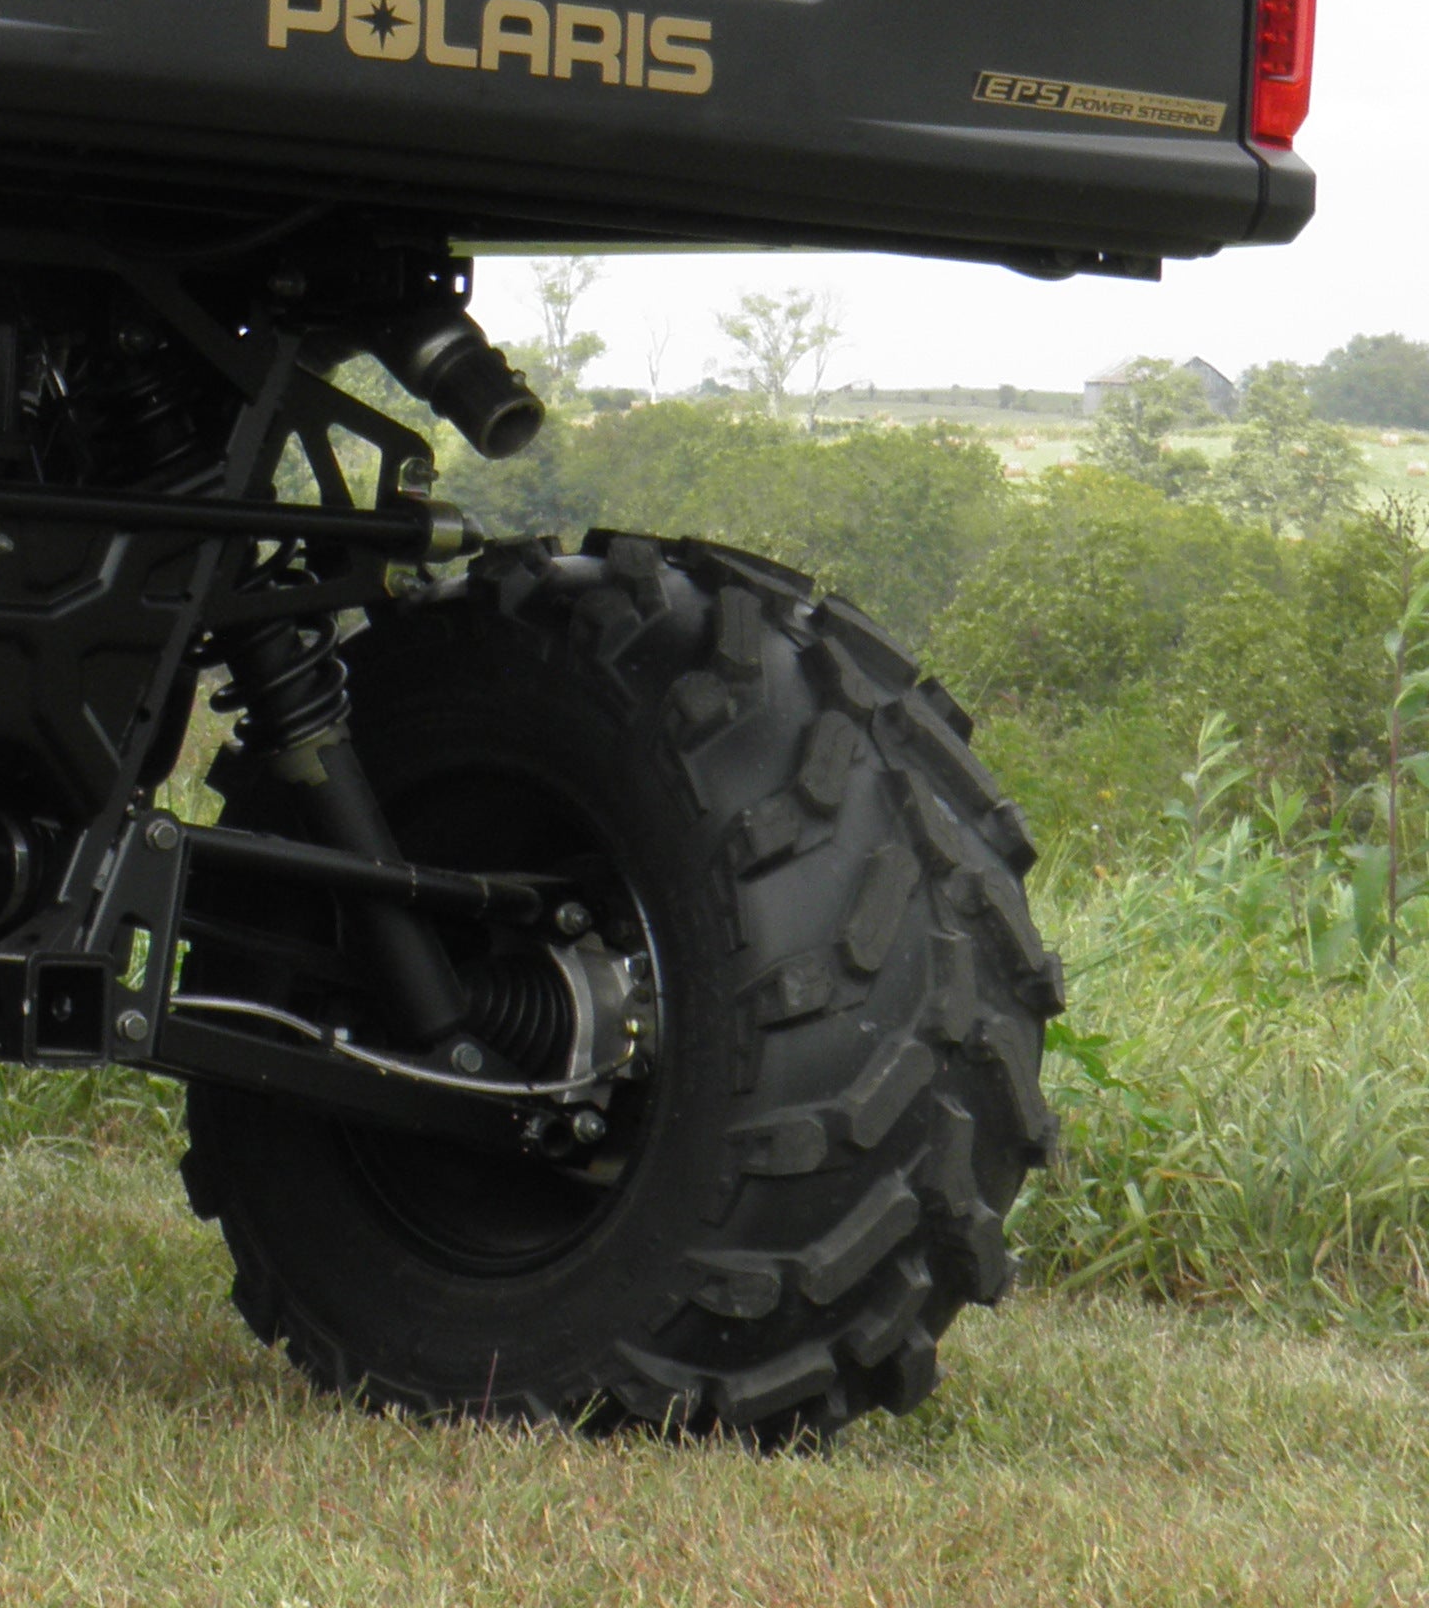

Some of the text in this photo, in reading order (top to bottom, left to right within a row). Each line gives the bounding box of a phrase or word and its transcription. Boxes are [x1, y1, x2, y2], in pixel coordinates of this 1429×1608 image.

[985, 77, 1063, 106] EPS
[1071, 97, 1216, 127] POWER STEERING
